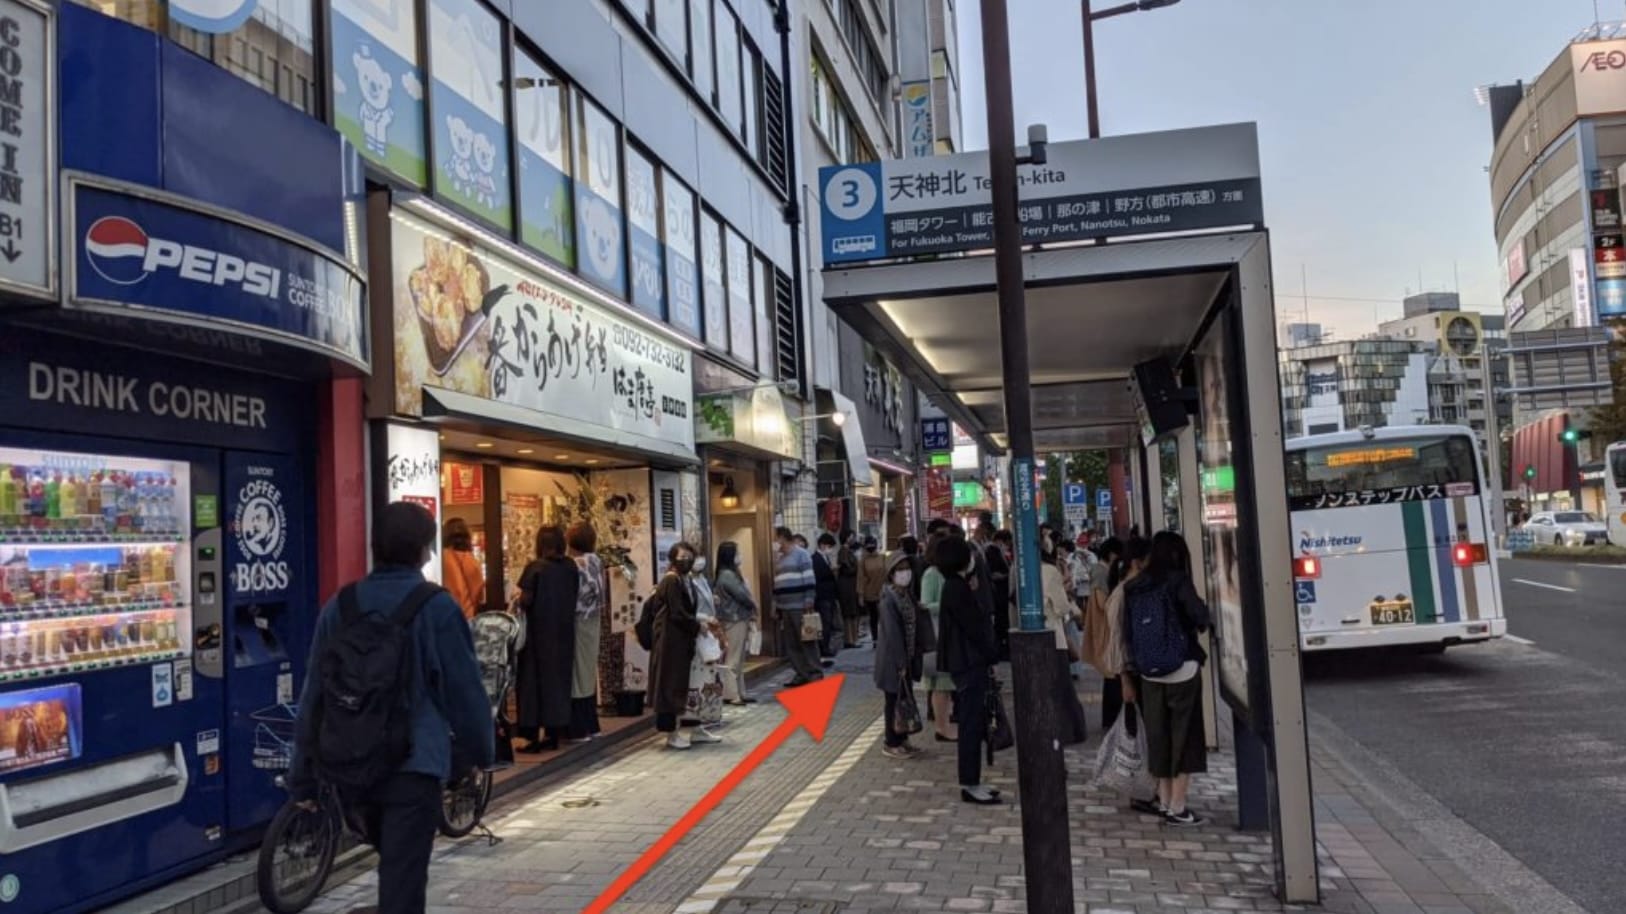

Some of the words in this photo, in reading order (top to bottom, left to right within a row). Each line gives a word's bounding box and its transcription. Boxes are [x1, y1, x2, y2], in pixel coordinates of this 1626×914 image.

[841, 180, 859, 206] 3
[889, 170, 966, 200] 天神北
[0, 213, 22, 240] B1
[890, 216, 958, 234] 福岡タワー
[1057, 201, 1101, 218] 那の津
[891, 238, 908, 248] For
[910, 233, 954, 246] Fukuoka
[956, 231, 989, 243] Tower,
[1022, 225, 1050, 237] Ferry
[1052, 223, 1079, 233] Port,
[1080, 217, 1129, 231] Nanotsu,
[1131, 213, 1171, 226] Nokata
[143, 237, 281, 299] PEPSI
[28, 362, 139, 412] DRINK
[148, 382, 267, 429] CORNER
[239, 480, 282, 505] COFFEE
[1069, 485, 1081, 502] P
[1100, 491, 1111, 506] P
[1314, 484, 1443, 508] ノンステップバス
[1300, 534, 1362, 549] Nishitetsu
[235, 560, 289, 592] BOSS
